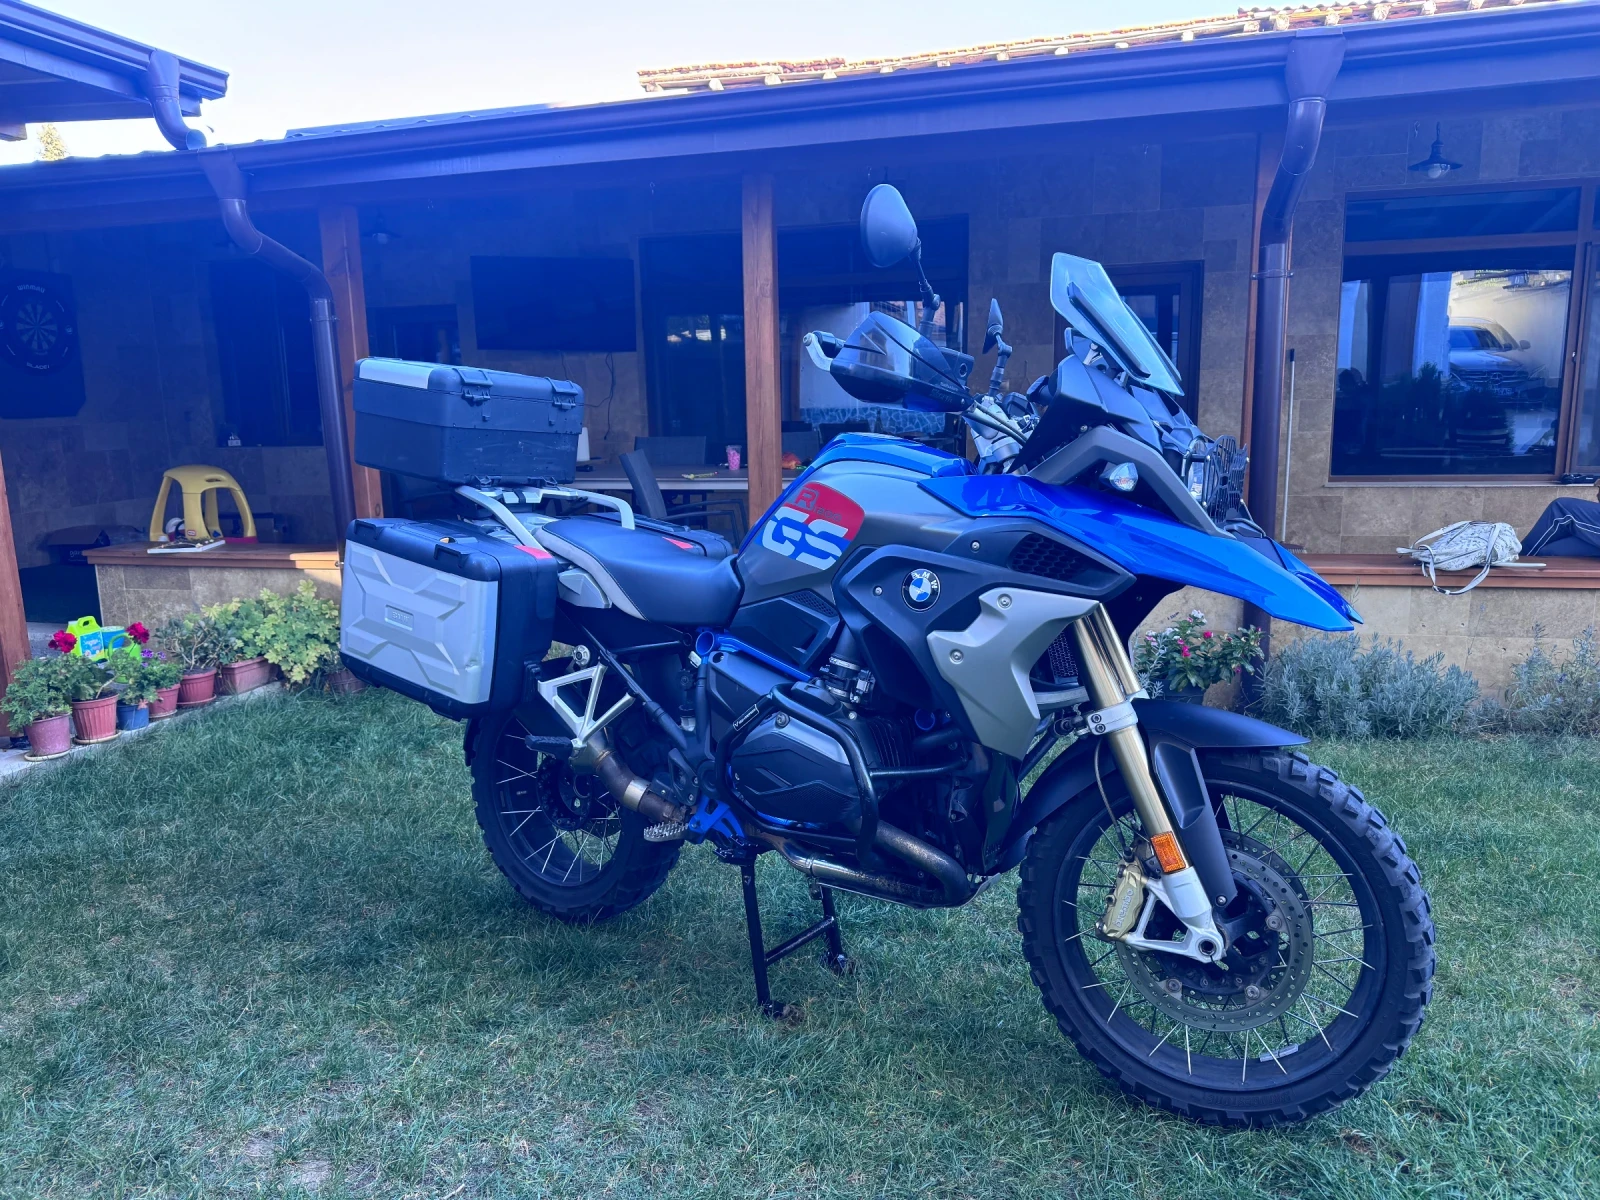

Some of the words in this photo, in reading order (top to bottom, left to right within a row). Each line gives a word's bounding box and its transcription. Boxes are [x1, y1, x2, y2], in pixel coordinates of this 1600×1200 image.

[762, 506, 849, 570] GS
[911, 571, 938, 589] BMW
[1112, 888, 1134, 928] brembo
